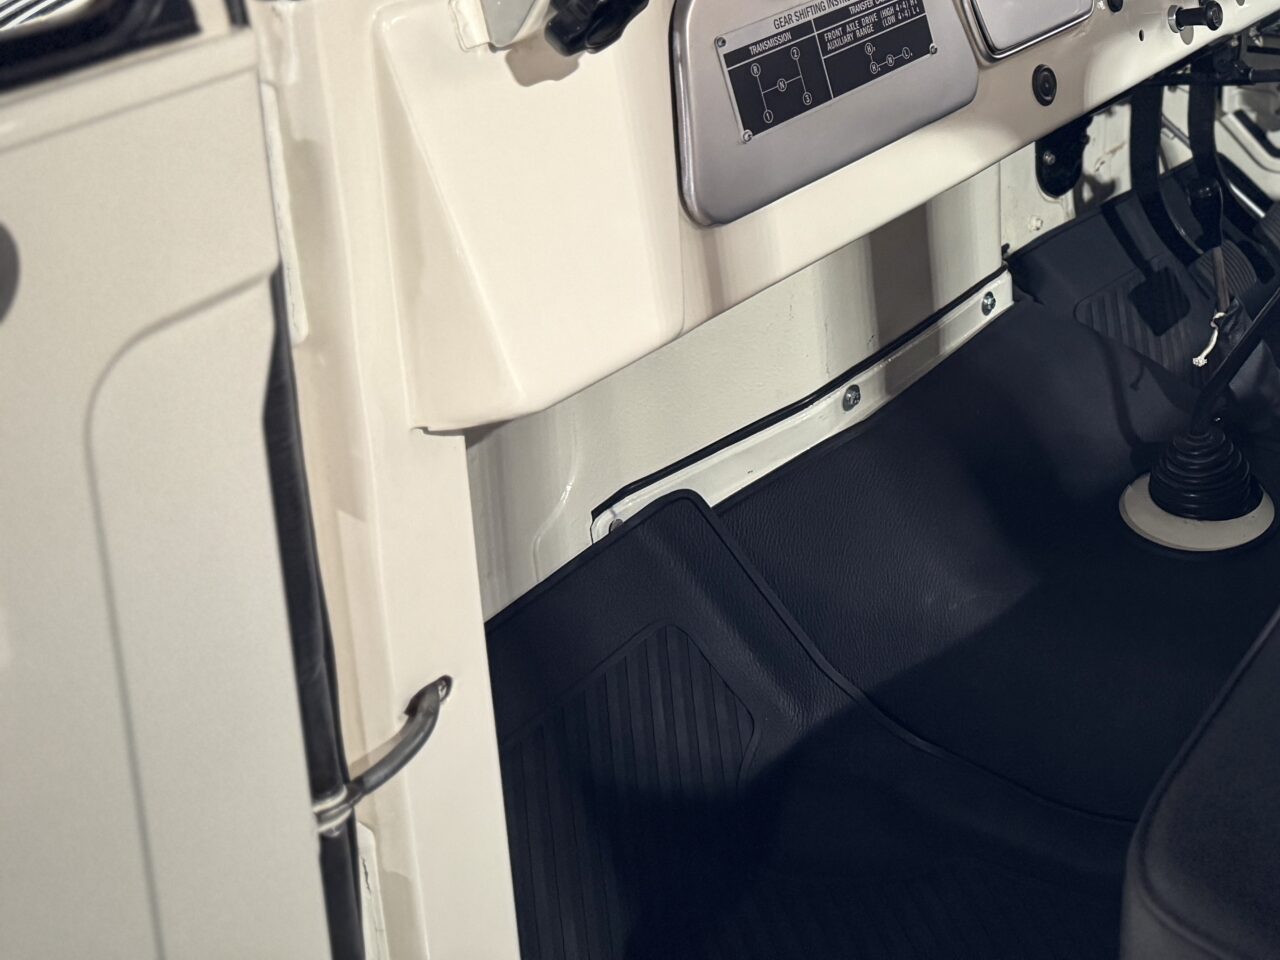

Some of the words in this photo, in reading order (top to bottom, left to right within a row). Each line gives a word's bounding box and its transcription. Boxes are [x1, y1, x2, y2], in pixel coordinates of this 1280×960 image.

[773, 15, 794, 30] GEAR
[794, 0, 827, 21] SHIFTING
[848, 0, 874, 15] TRANSFER
[824, 27, 843, 41] FRONT
[846, 20, 860, 33] AXLE
[861, 13, 878, 26] DRIVE
[827, 33, 854, 51] AUXILIARY
[856, 24, 874, 38] RANGE
[748, 32, 792, 55] TRANSMISSION
